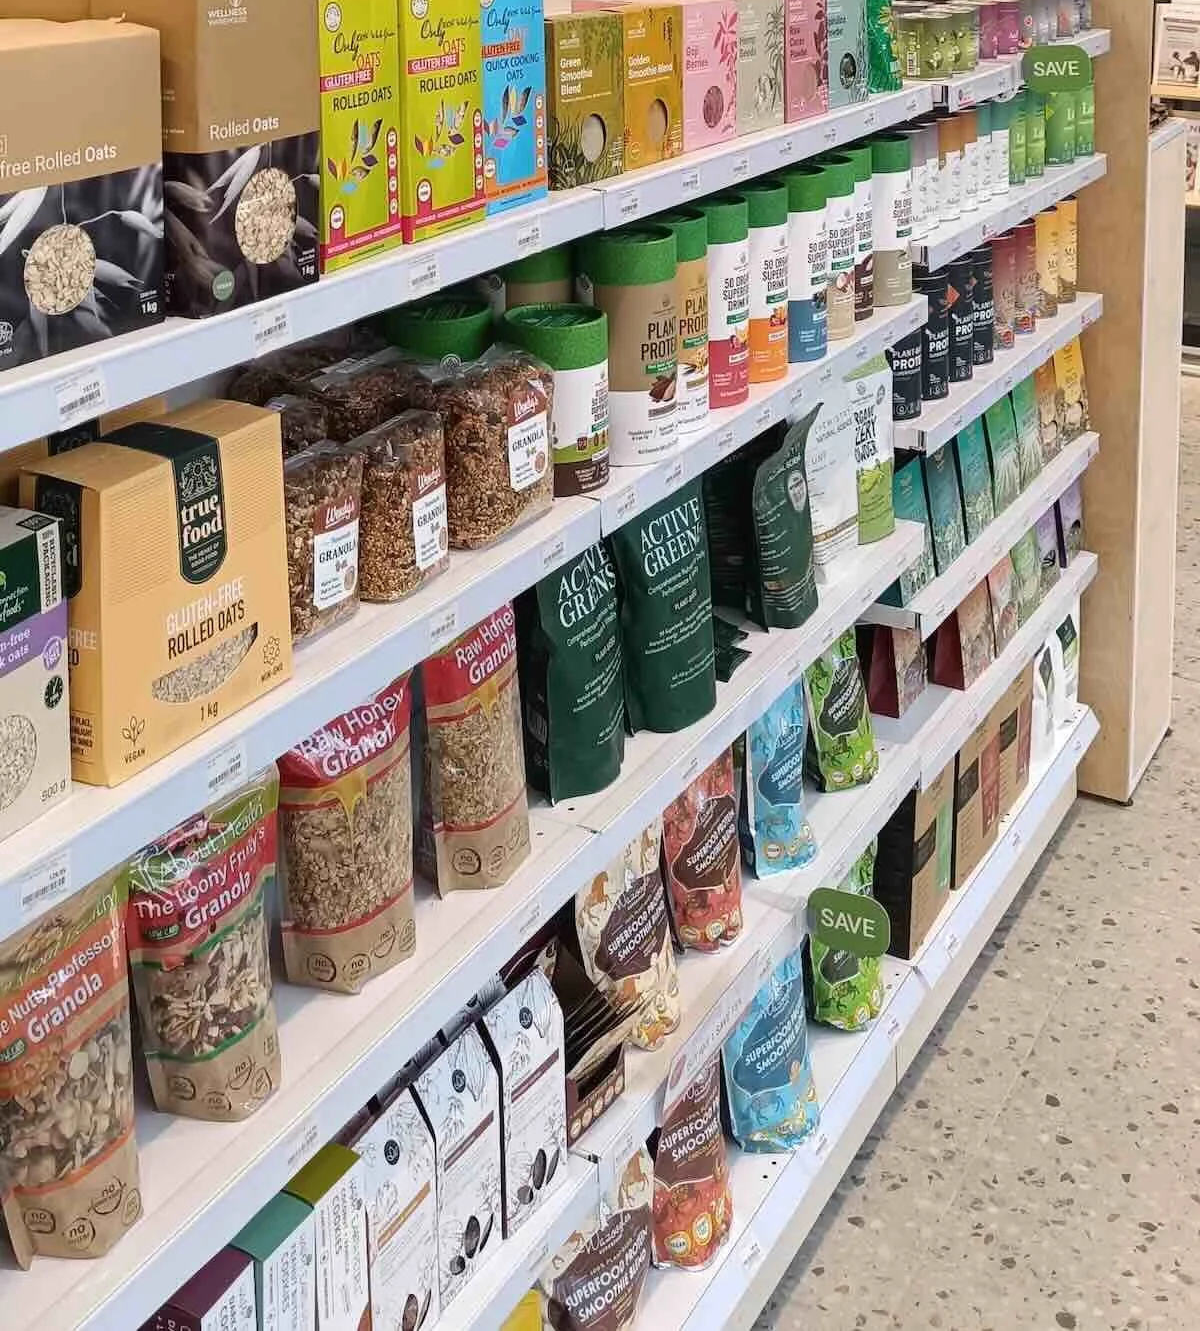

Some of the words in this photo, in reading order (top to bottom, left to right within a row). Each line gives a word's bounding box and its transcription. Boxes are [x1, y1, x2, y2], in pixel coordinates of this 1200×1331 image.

[207, 6, 248, 19] WELLNESS
[441, 37, 466, 55] OATS
[506, 40, 521, 53] FREE
[356, 51, 381, 71] OATS
[411, 56, 441, 72] GLUTEN
[441, 53, 457, 67] FREE
[485, 57, 510, 72] QUICK
[510, 52, 540, 68] COOKING
[560, 58, 581, 69] Green
[628, 54, 650, 66] Golden
[1033, 60, 1081, 77] SAVE
[324, 71, 353, 88] GLUTEN
[355, 69, 372, 83] FREE
[419, 74, 457, 93] ROLLED
[457, 69, 478, 84] OATS
[506, 69, 525, 82] OATS
[560, 69, 593, 82] Smoothie
[628, 66, 657, 79] Smoothie
[333, 90, 370, 112] ROLLED
[371, 86, 393, 103] OATS
[560, 84, 582, 96] Blend
[209, 120, 250, 141] Rolled
[253, 116, 280, 134] Oats
[35, 148, 81, 173] Rolled
[84, 143, 118, 163] Oats
[763, 259, 774, 270] 50
[724, 277, 735, 289] 50
[685, 296, 708, 316] PLAN
[641, 336, 677, 361] PROTE
[512, 428, 544, 453] GRANOLA
[181, 492, 219, 524] true
[182, 509, 224, 550] food
[641, 497, 701, 554] ACTIVE
[42, 541, 51, 608] PACKAGING
[166, 575, 245, 636] GLUTEN-FREE
[0, 629, 32, 653] n-free
[168, 620, 214, 660] ROLLED
[218, 600, 246, 631] OATS
[8, 643, 30, 663] oats
[455, 639, 482, 670] Raw
[469, 631, 517, 686] Granola
[200, 706, 205, 721] 1
[206, 700, 219, 718] kg
[299, 724, 345, 759] Raw
[343, 687, 404, 734] Honey
[123, 747, 147, 765] VEGAN
[221, 793, 265, 845] Health
[686, 831, 718, 868] SUPERFOOD
[132, 900, 174, 919] The
[175, 860, 229, 908] Loony
[185, 870, 252, 930] Granola
[607, 910, 648, 956] SUPERFOOD
[820, 907, 876, 939] SAVE
[617, 918, 653, 962] SMOOTHIE
[351, 958, 365, 969] no
[8, 984, 56, 1025] Nutty
[27, 971, 104, 1045] Granola
[744, 1015, 793, 1067] SUPERFOOD
[234, 1061, 248, 1075] no
[208, 1095, 223, 1106] no
[658, 1106, 714, 1153] SUPERFOOD
[101, 1183, 117, 1198] no
[30, 1210, 47, 1221] no
[332, 1194, 343, 1255] COOKIES
[69, 1223, 86, 1238] no
[565, 1259, 624, 1312] SUPERFOOD
[578, 1275, 629, 1323] SMOOTHIE
